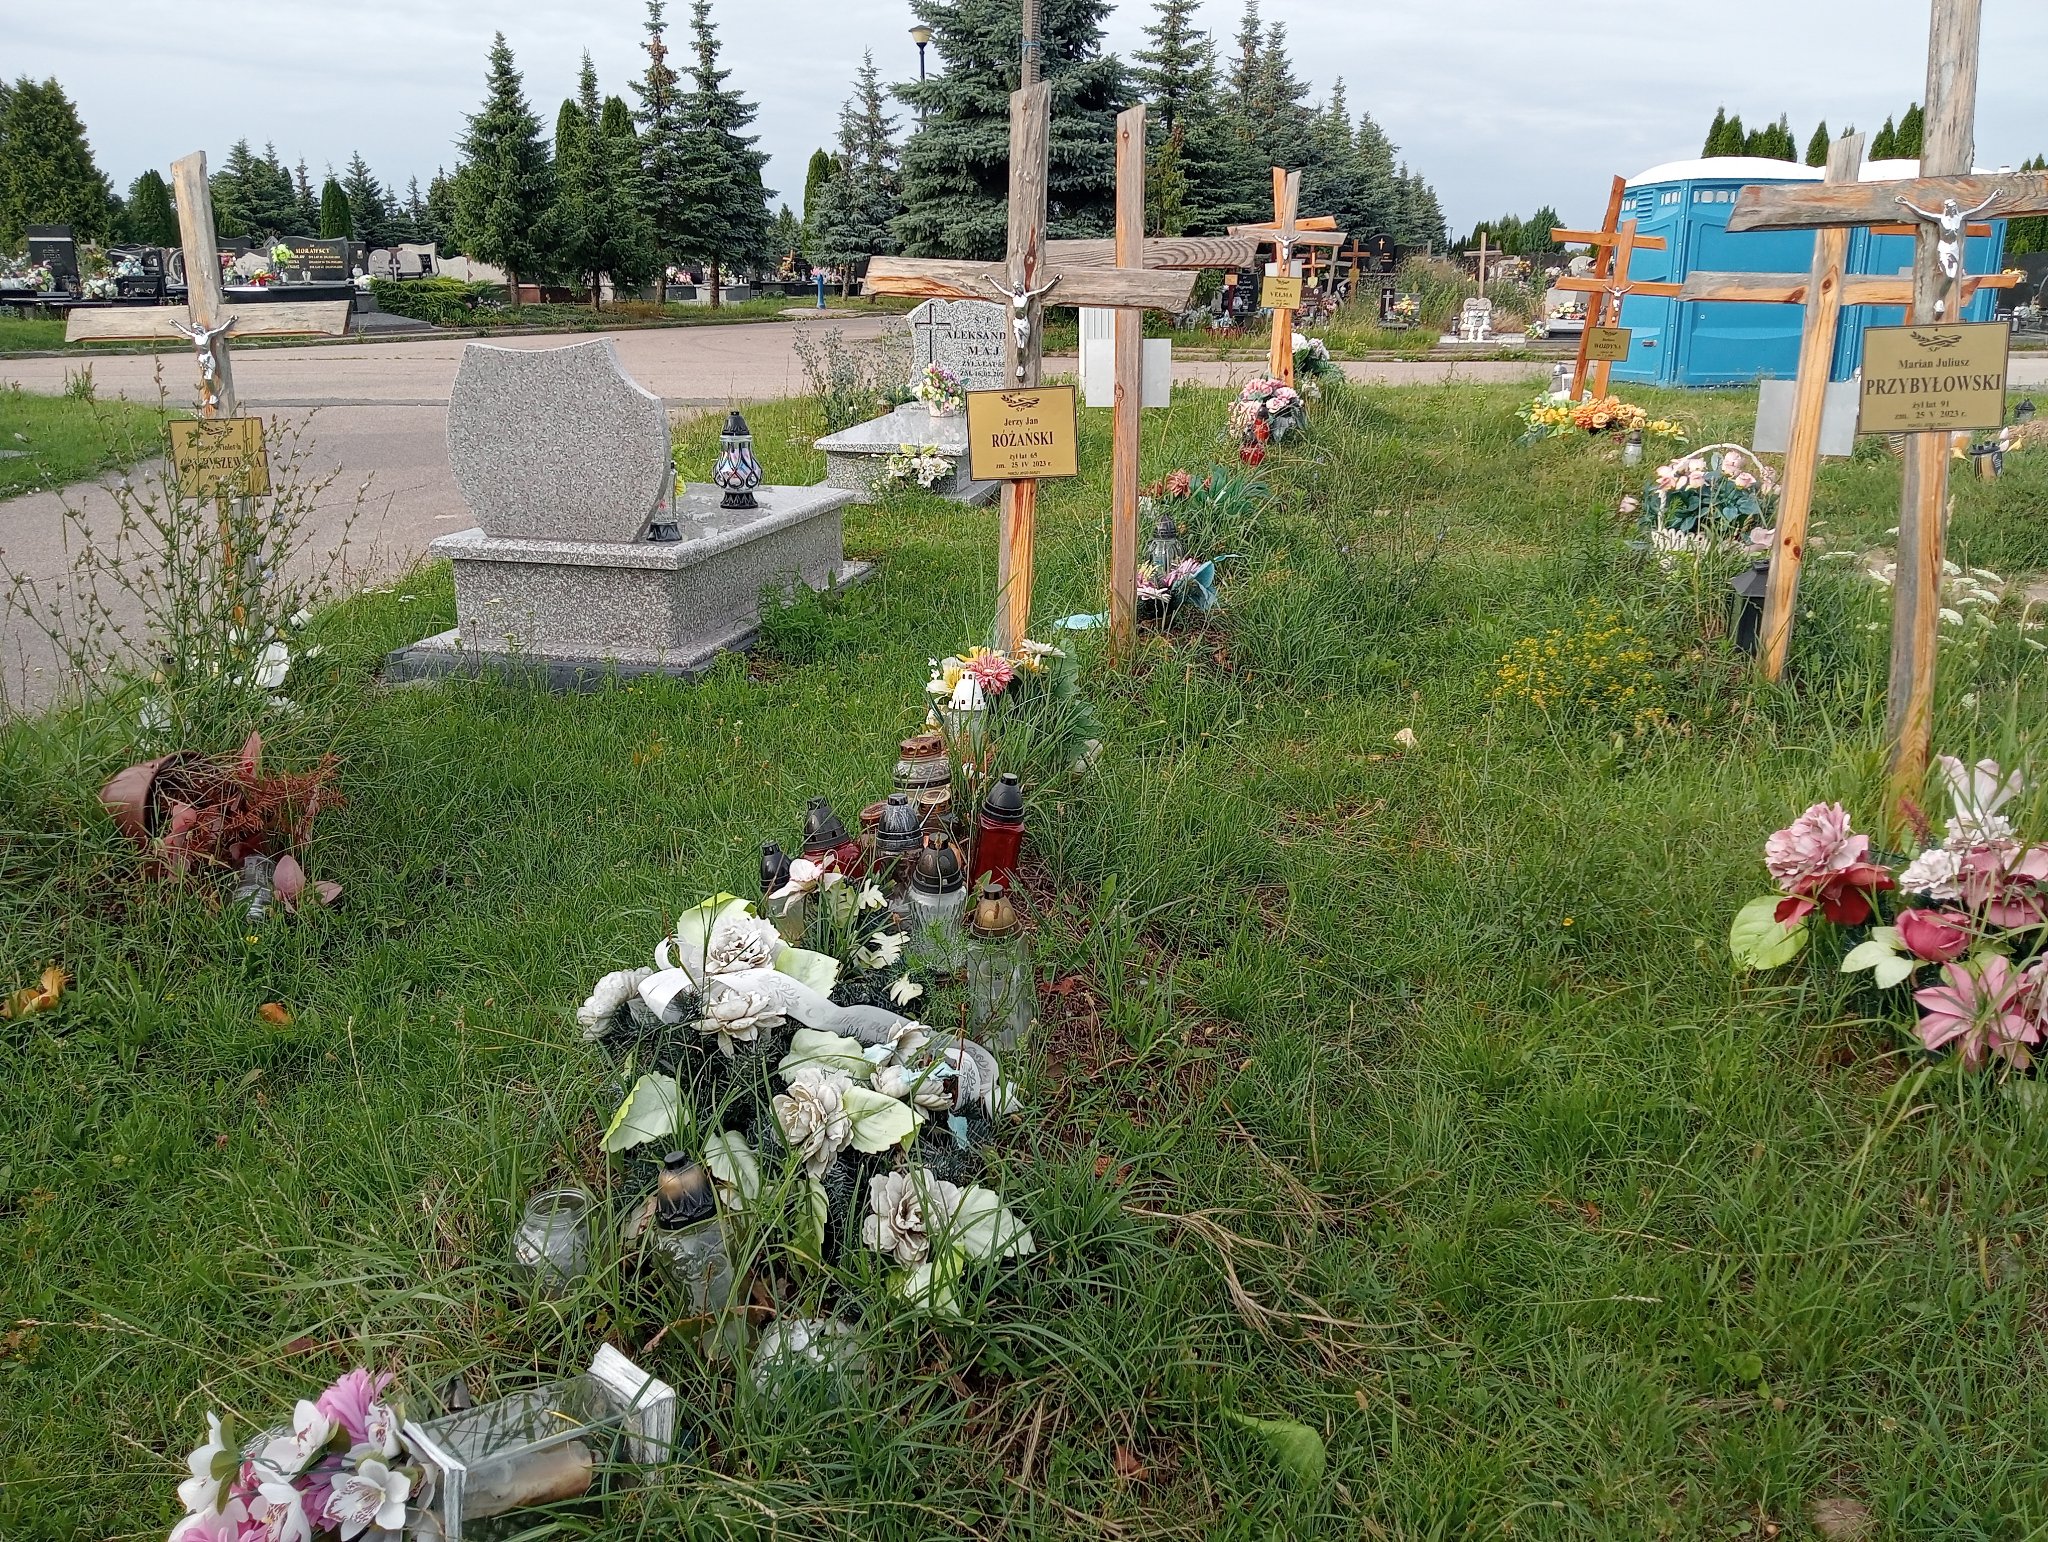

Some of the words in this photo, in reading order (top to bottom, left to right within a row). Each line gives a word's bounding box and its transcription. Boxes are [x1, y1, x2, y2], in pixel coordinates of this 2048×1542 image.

[945, 331, 1006, 340] ALEKSAND
[1898, 359, 1933, 369] Marian
[1936, 358, 1970, 368] Juliusz
[1865, 374, 2001, 396] PRZYBYŁOWSKI
[1916, 411, 1925, 419] 25
[1940, 410, 1959, 418] 2023
[1003, 418, 1023, 427] Jerzy
[1025, 417, 1039, 426] Jan
[992, 427, 1054, 448] RÓŻAŃSKI
[1019, 452, 1027, 460] lat
[1011, 461, 1019, 469] 25
[1033, 460, 1047, 468] 2023
